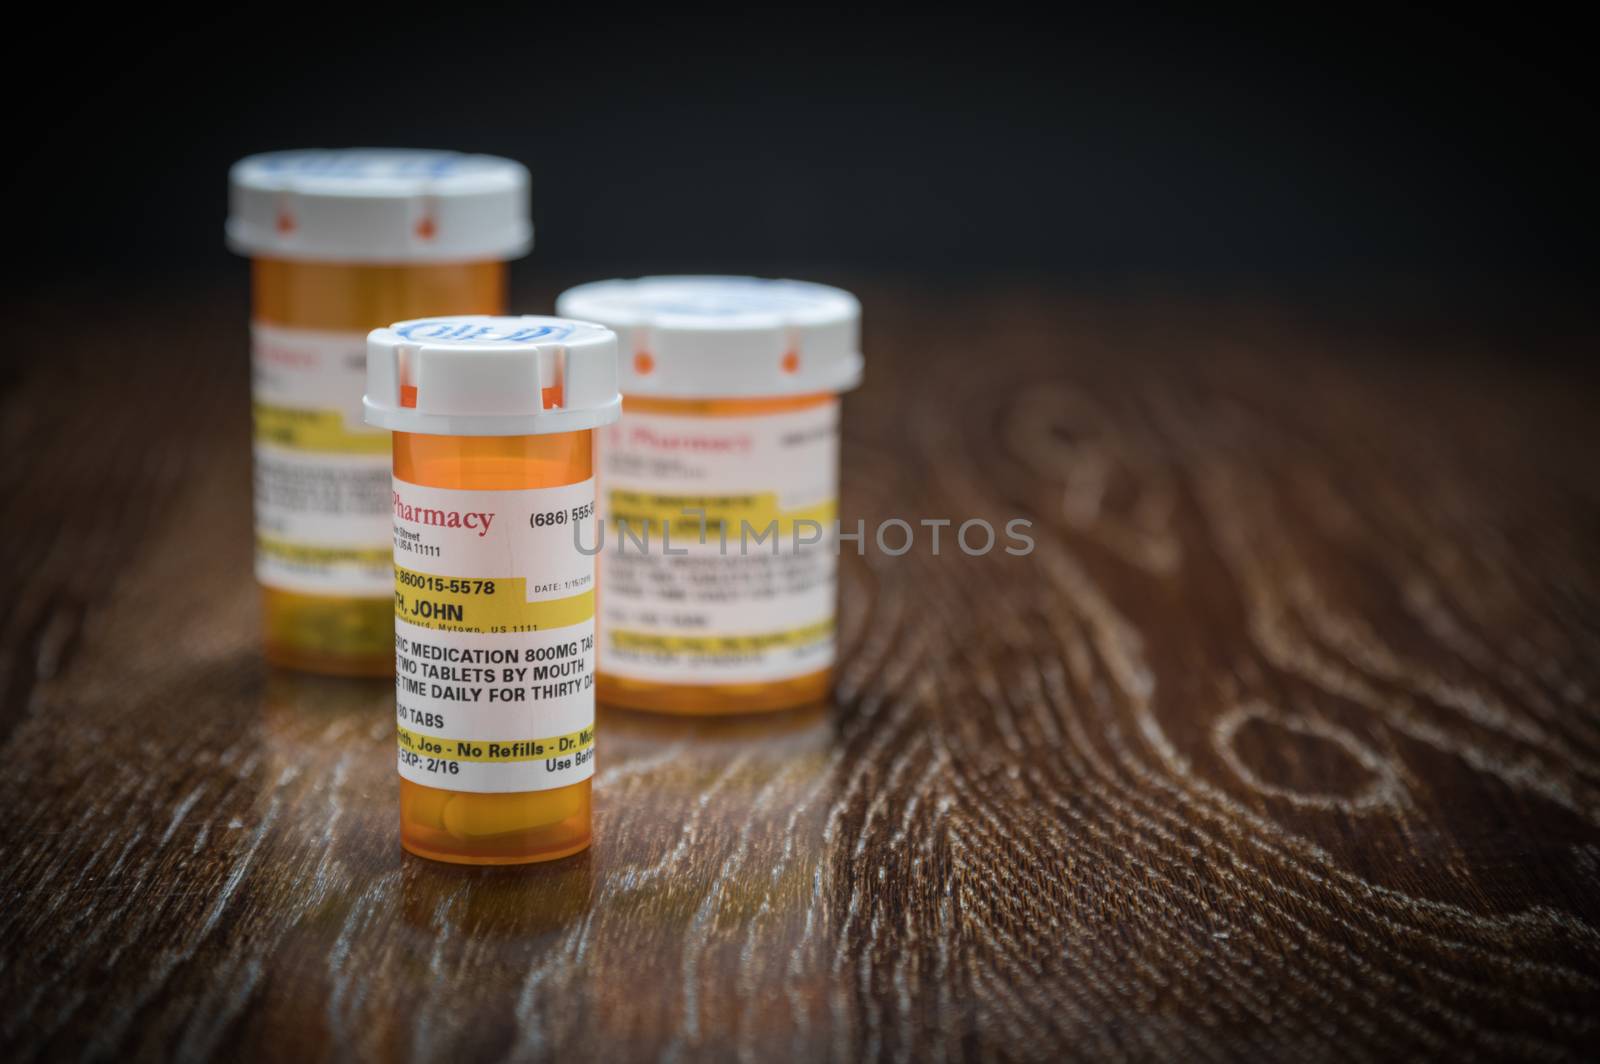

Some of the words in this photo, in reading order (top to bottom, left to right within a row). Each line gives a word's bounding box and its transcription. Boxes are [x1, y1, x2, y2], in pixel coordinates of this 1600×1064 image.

[530, 508, 568, 529] (686)
[399, 527, 420, 542] Street
[414, 543, 440, 557] 11111
[400, 570, 495, 595] 860015-5578
[534, 583, 561, 593] DATE:
[411, 600, 463, 622] JOHN
[438, 623, 485, 634] Mytown,
[490, 626, 507, 634] US
[512, 624, 538, 633] 1111
[411, 642, 519, 664] MEDICATION
[525, 642, 577, 663] 800MG
[398, 654, 417, 674] TWO
[421, 663, 496, 683] TABLETS
[502, 668, 527, 683] BY
[533, 658, 584, 681] MOUTH
[401, 676, 427, 697] TIME
[431, 684, 482, 703] DAILY
[489, 687, 525, 703] FOR
[531, 678, 582, 701] THIRTY
[409, 708, 444, 729] TABS
[417, 736, 442, 754] Joe
[457, 742, 482, 758] No
[488, 742, 544, 759] Refills
[558, 737, 576, 753] Dr.
[401, 748, 423, 770] EXP:
[426, 758, 460, 775] 2/16
[545, 758, 571, 773] Use
